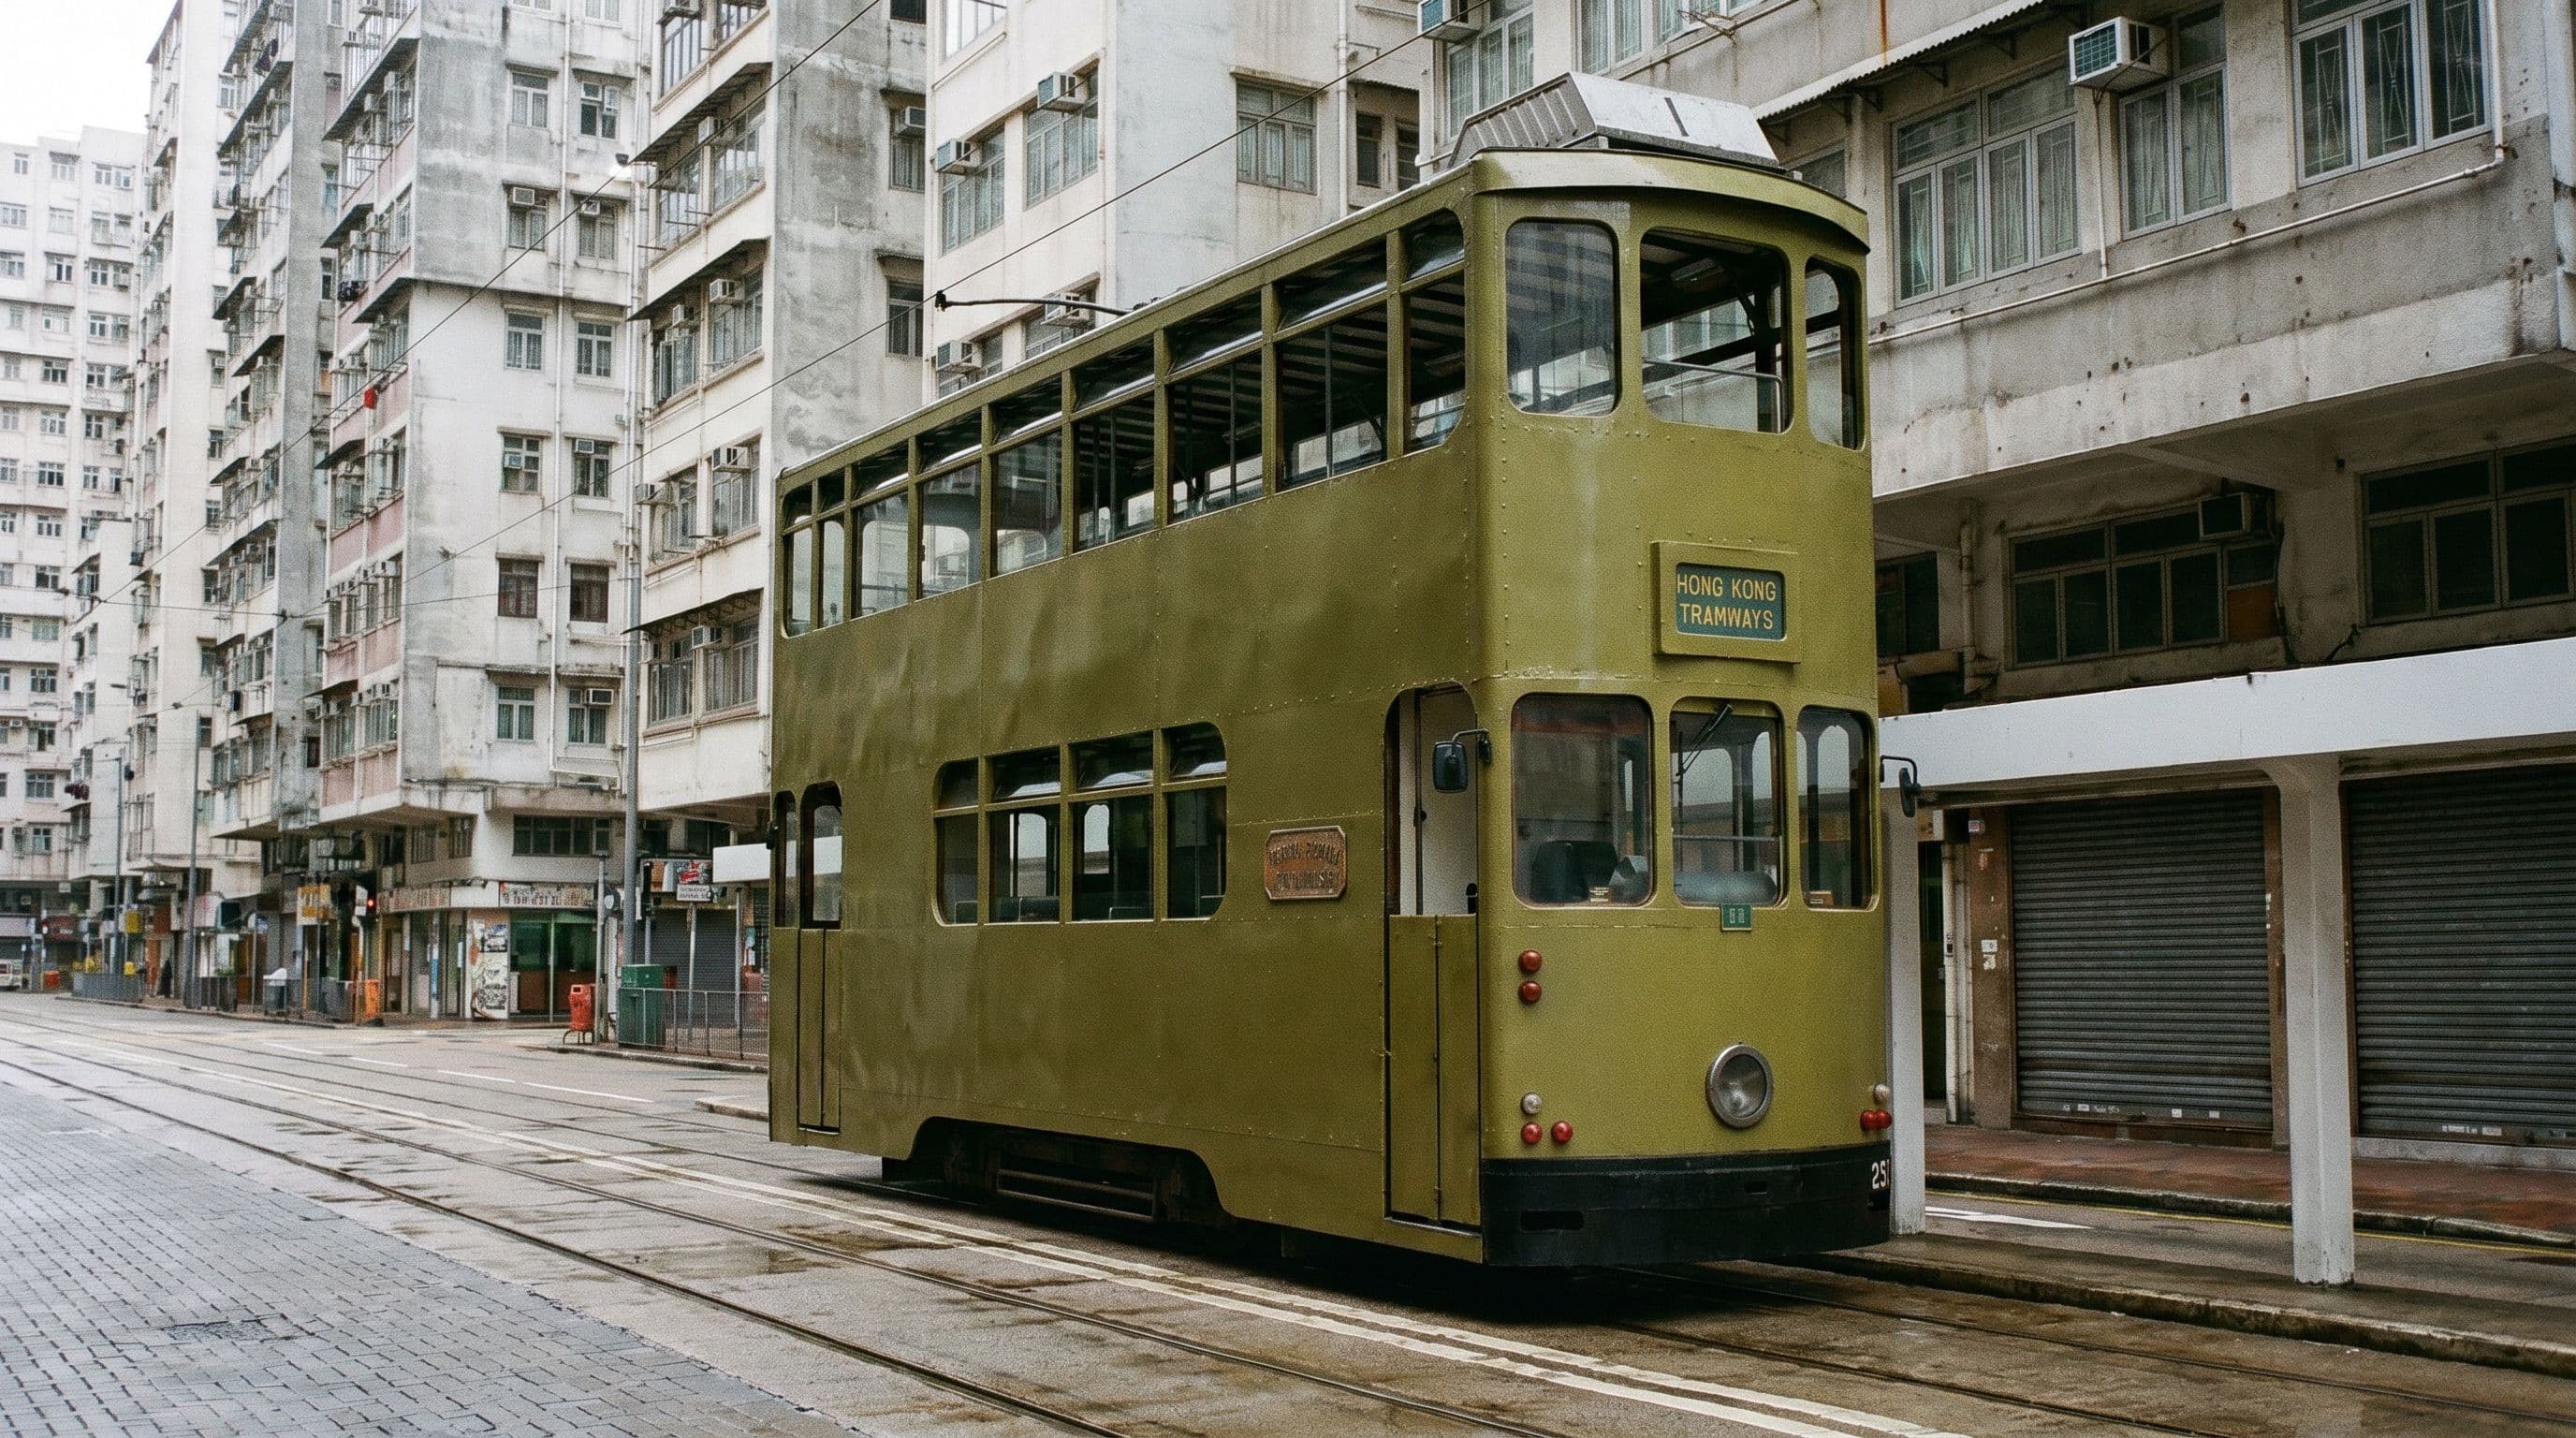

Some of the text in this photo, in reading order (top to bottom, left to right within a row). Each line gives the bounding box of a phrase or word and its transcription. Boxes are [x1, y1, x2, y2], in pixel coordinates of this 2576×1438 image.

[1676, 573, 1777, 601] HONG KONG
[1679, 603, 1774, 630] TRAMWAYS
